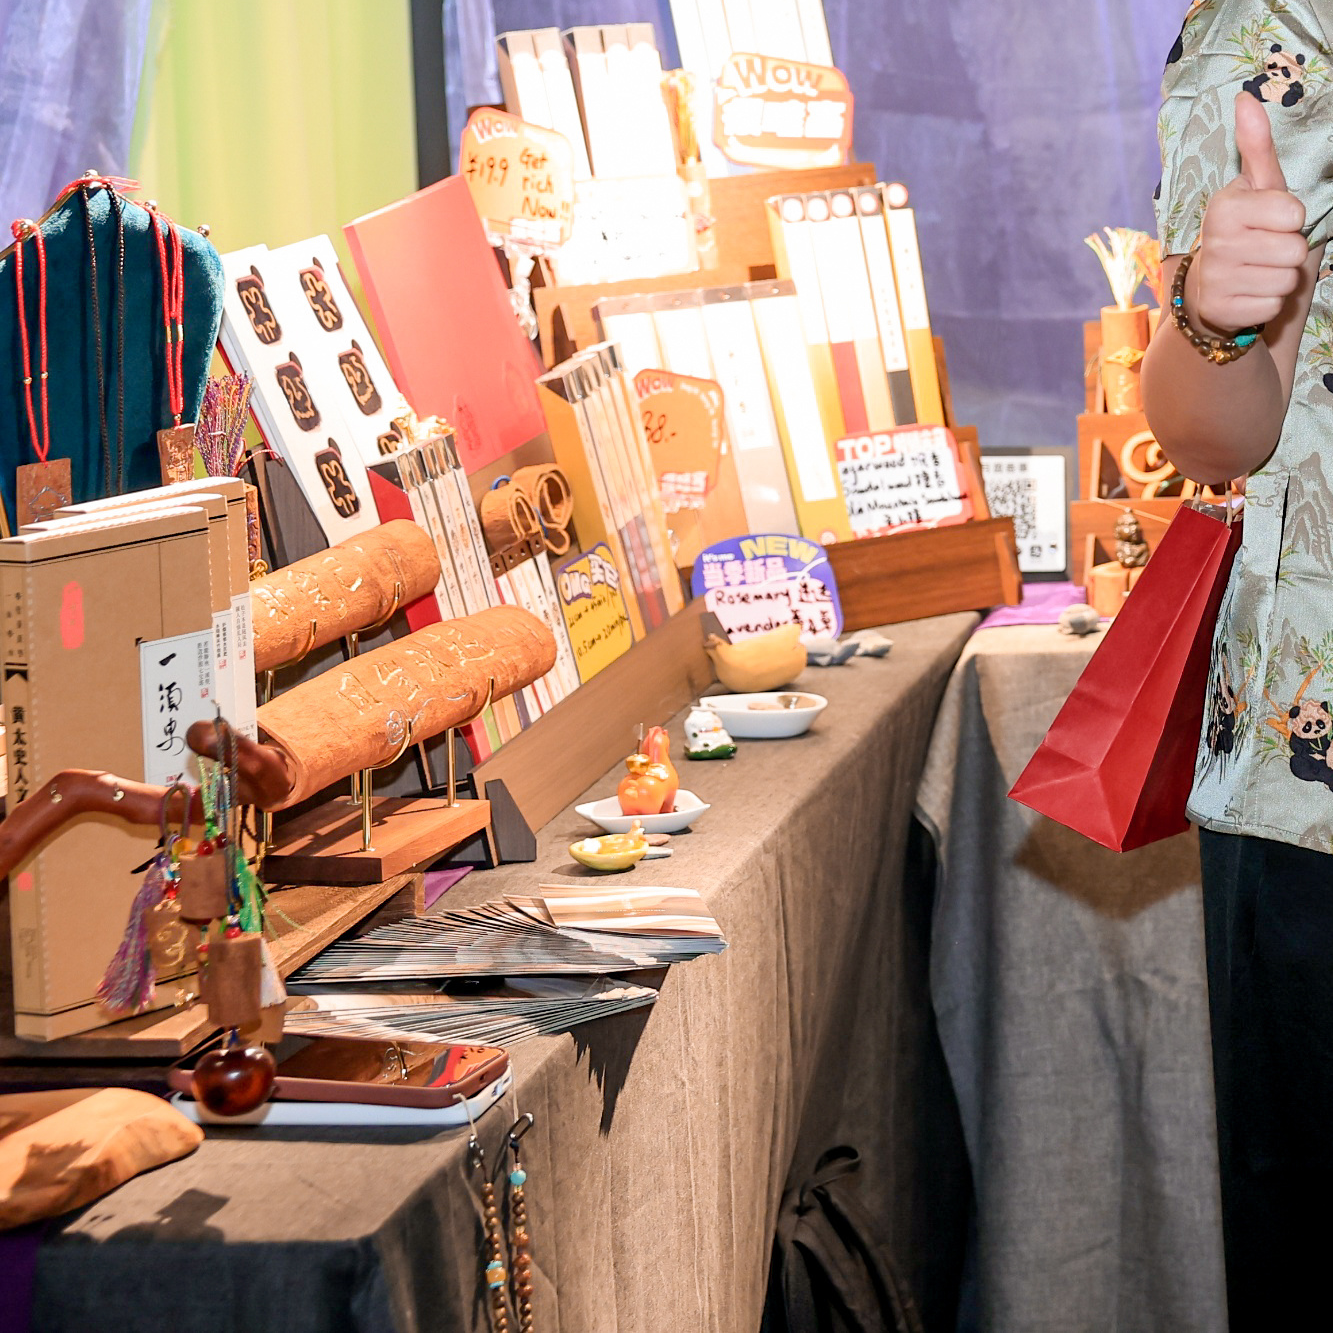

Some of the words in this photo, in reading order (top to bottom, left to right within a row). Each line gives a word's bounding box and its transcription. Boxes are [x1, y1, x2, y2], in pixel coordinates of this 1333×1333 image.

[837, 433, 893, 462] TOP
[738, 536, 820, 564] NEW
[559, 571, 592, 605] OMG
[714, 588, 793, 607] Rosemary
